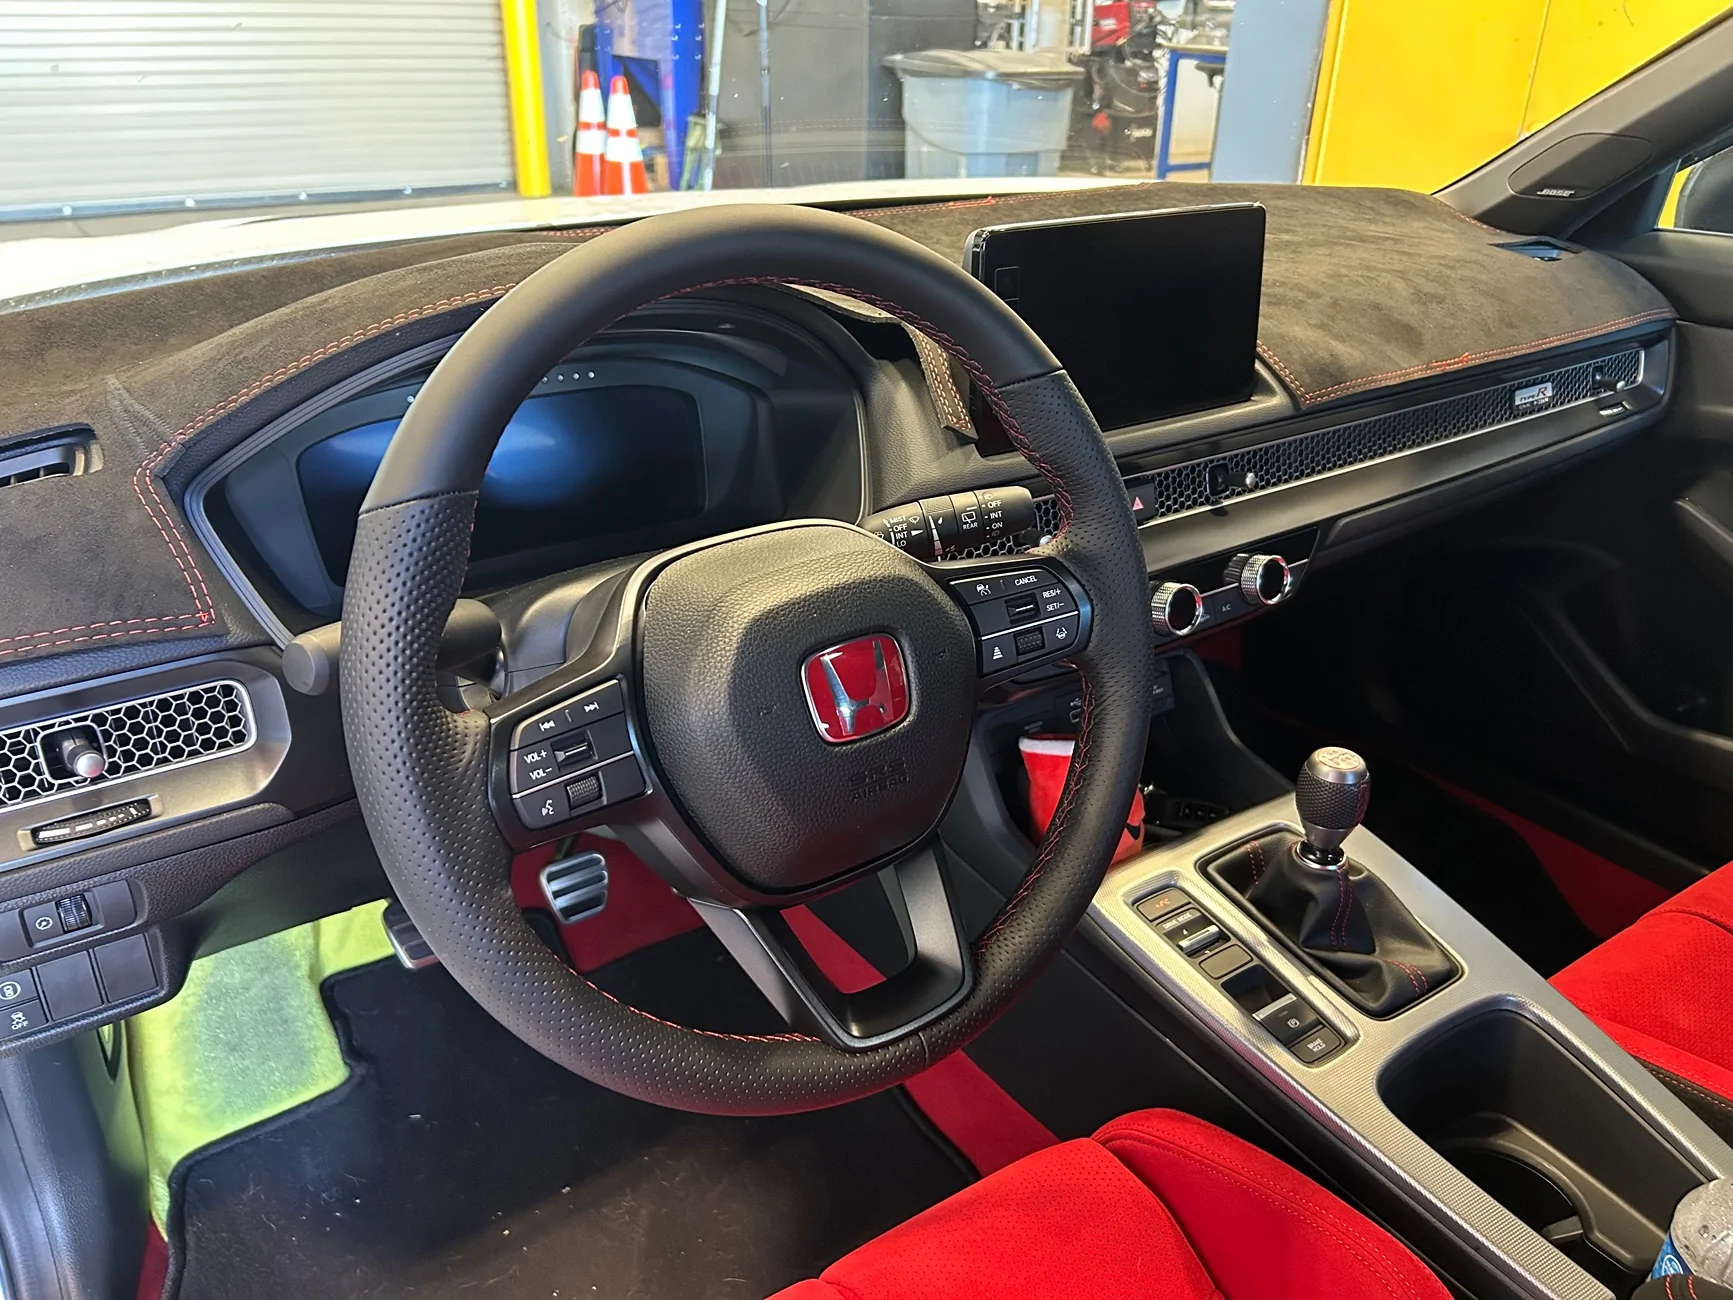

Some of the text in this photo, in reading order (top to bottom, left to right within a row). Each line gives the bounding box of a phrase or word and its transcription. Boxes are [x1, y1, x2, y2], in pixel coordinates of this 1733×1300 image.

[1537, 188, 1575, 197] BOSE
[1536, 386, 1548, 398] R
[988, 500, 1002, 508] OFF
[890, 515, 907, 524] MIST
[990, 511, 1003, 519] INT
[894, 523, 908, 532] OFF
[962, 522, 978, 530] REAR
[896, 531, 908, 539] INT
[897, 540, 907, 548] LO
[1014, 575, 1038, 586] CANCEL
[1042, 588, 1061, 598] RES/+
[524, 749, 547, 764] VOL+
[529, 767, 552, 780] VOL-
[11, 1021, 28, 1030] OFF
[1307, 1038, 1323, 1049] BRAKE
[1313, 1042, 1326, 1052] HOLD
